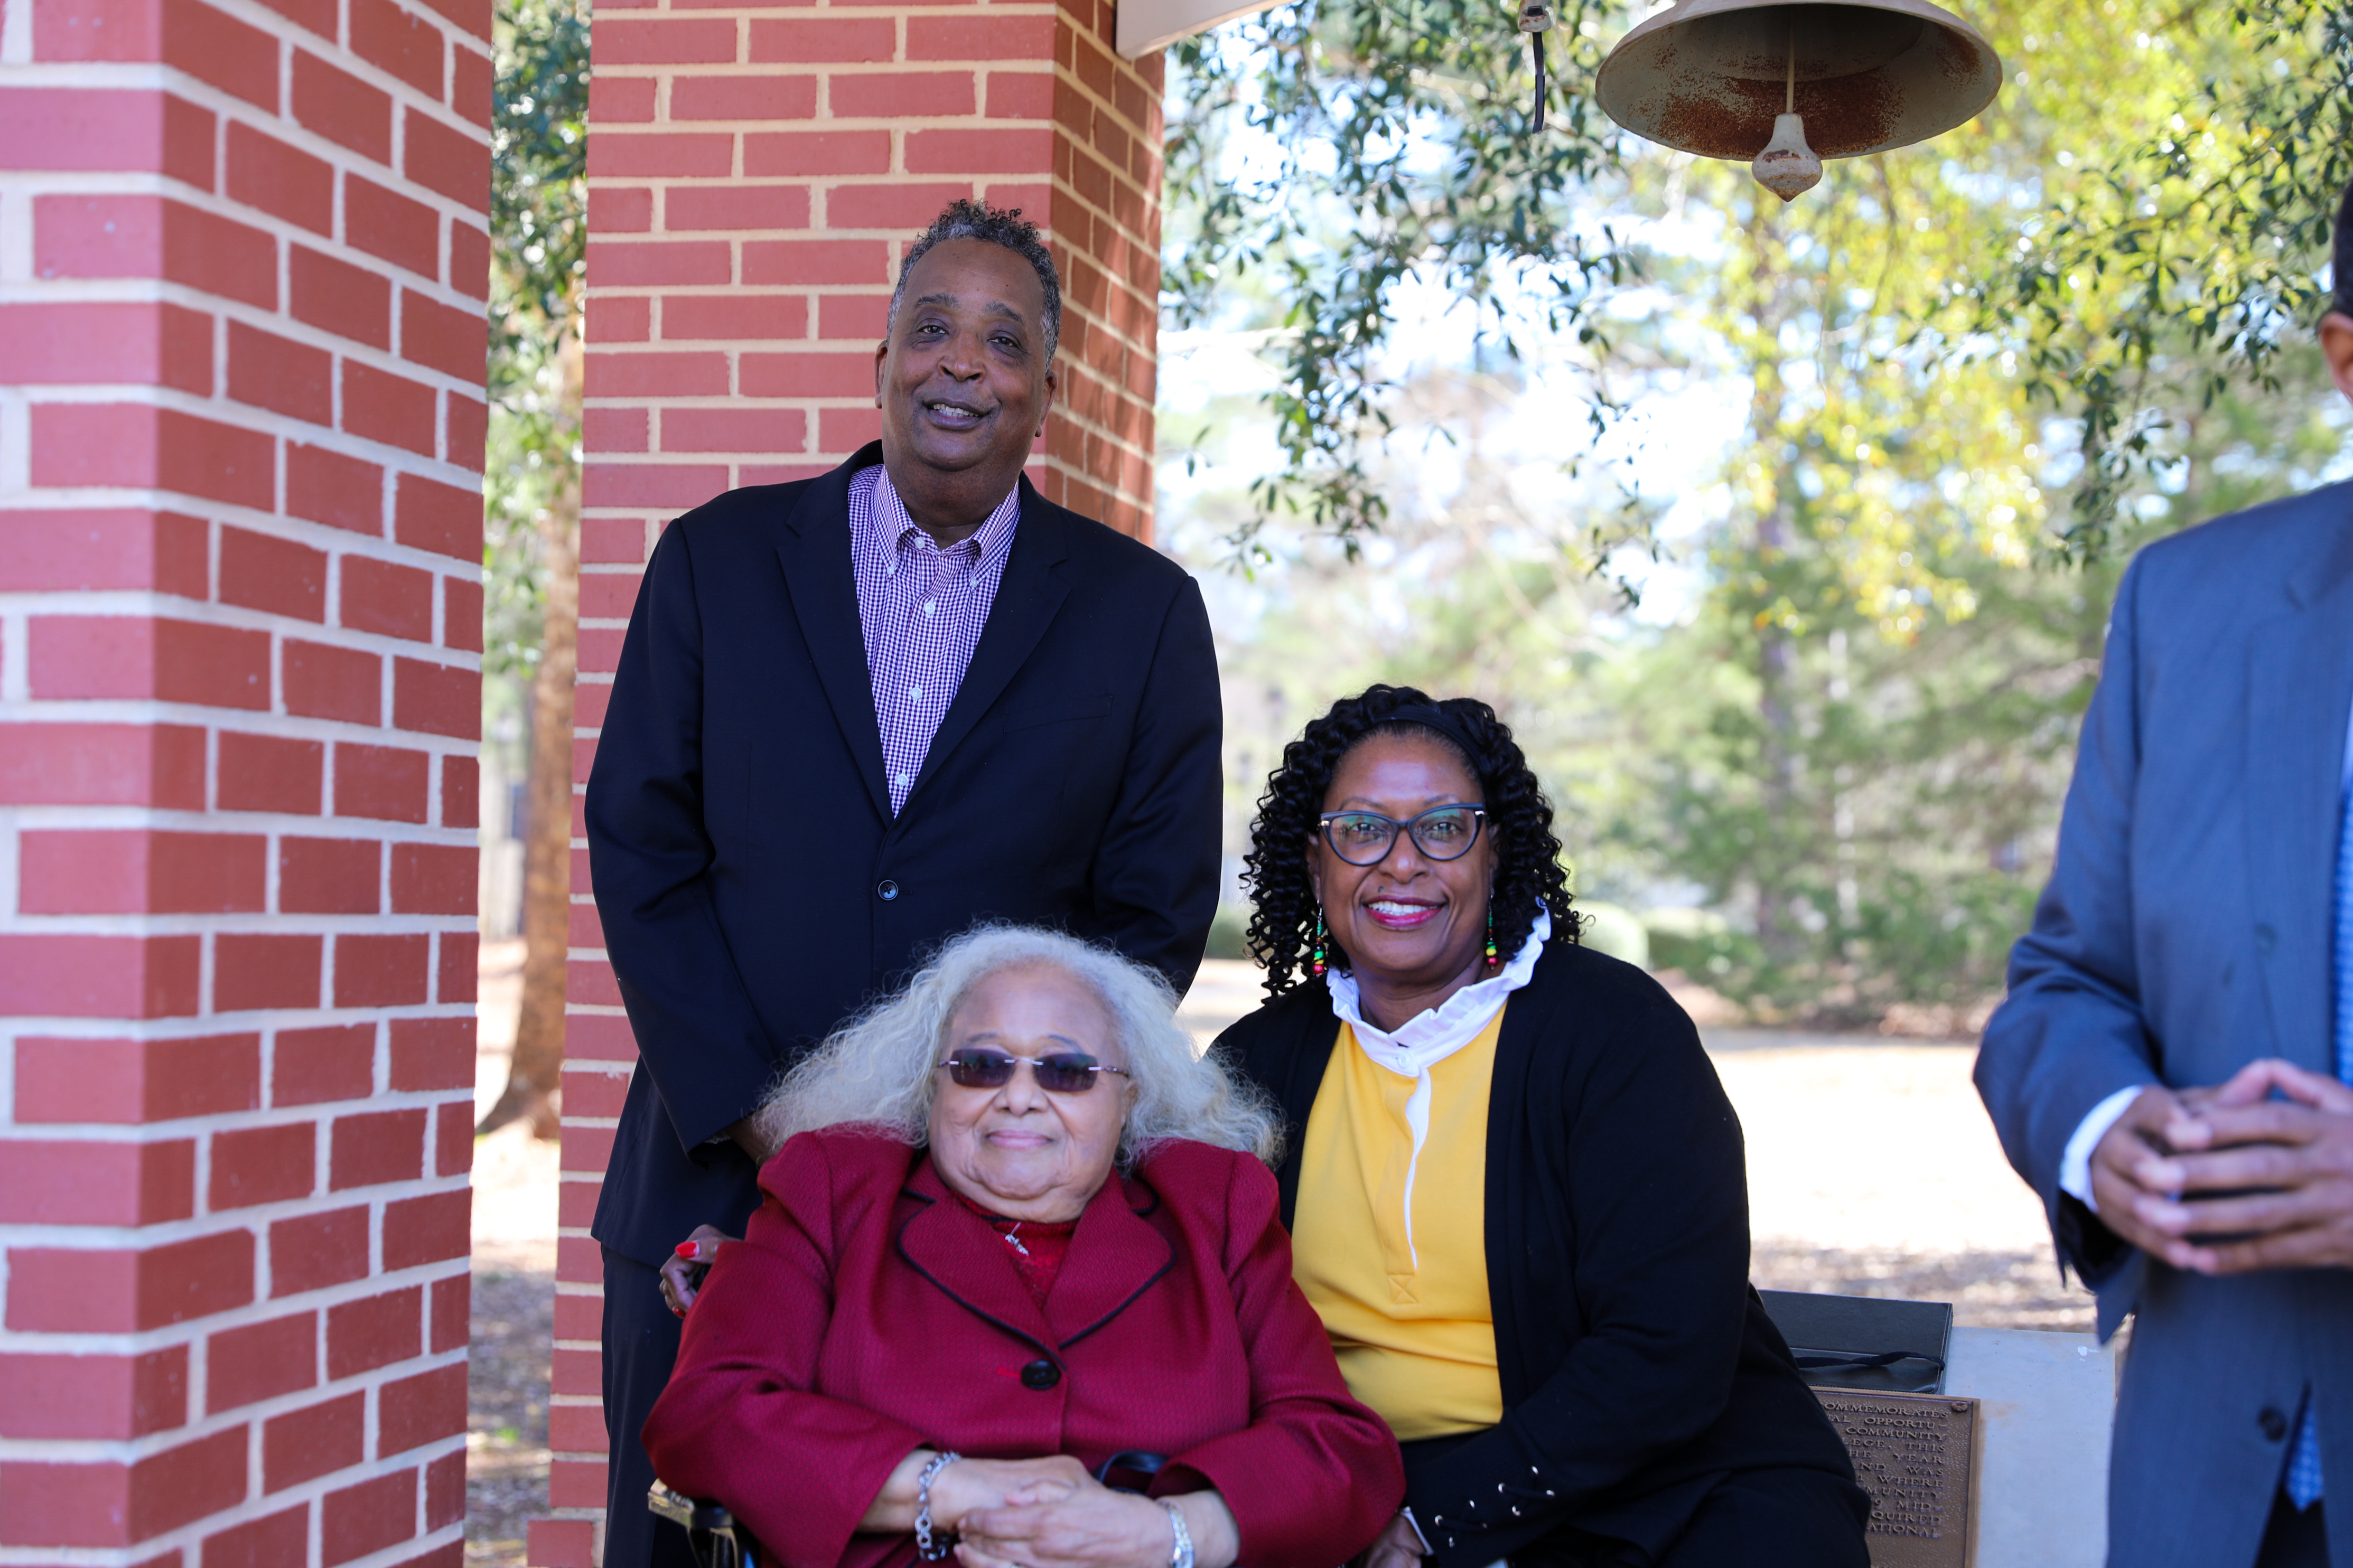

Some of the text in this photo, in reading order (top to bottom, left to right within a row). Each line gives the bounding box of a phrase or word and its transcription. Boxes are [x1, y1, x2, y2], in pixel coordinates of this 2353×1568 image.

[1824, 1403, 1948, 1419] OMMEMORATES
[1846, 1427, 1946, 1441] COMMUNITY
[1842, 1438, 1946, 1452] LEGE. THIS
[1849, 1450, 1944, 1464] HE YEAR
[1853, 1462, 1944, 1476] ND WAS
[1877, 1475, 1943, 1488] WHERE
[1866, 1486, 1945, 1500] MUNITY
[1871, 1511, 1942, 1523] QUIRED
[1868, 1523, 1940, 1535] ATIONAL
